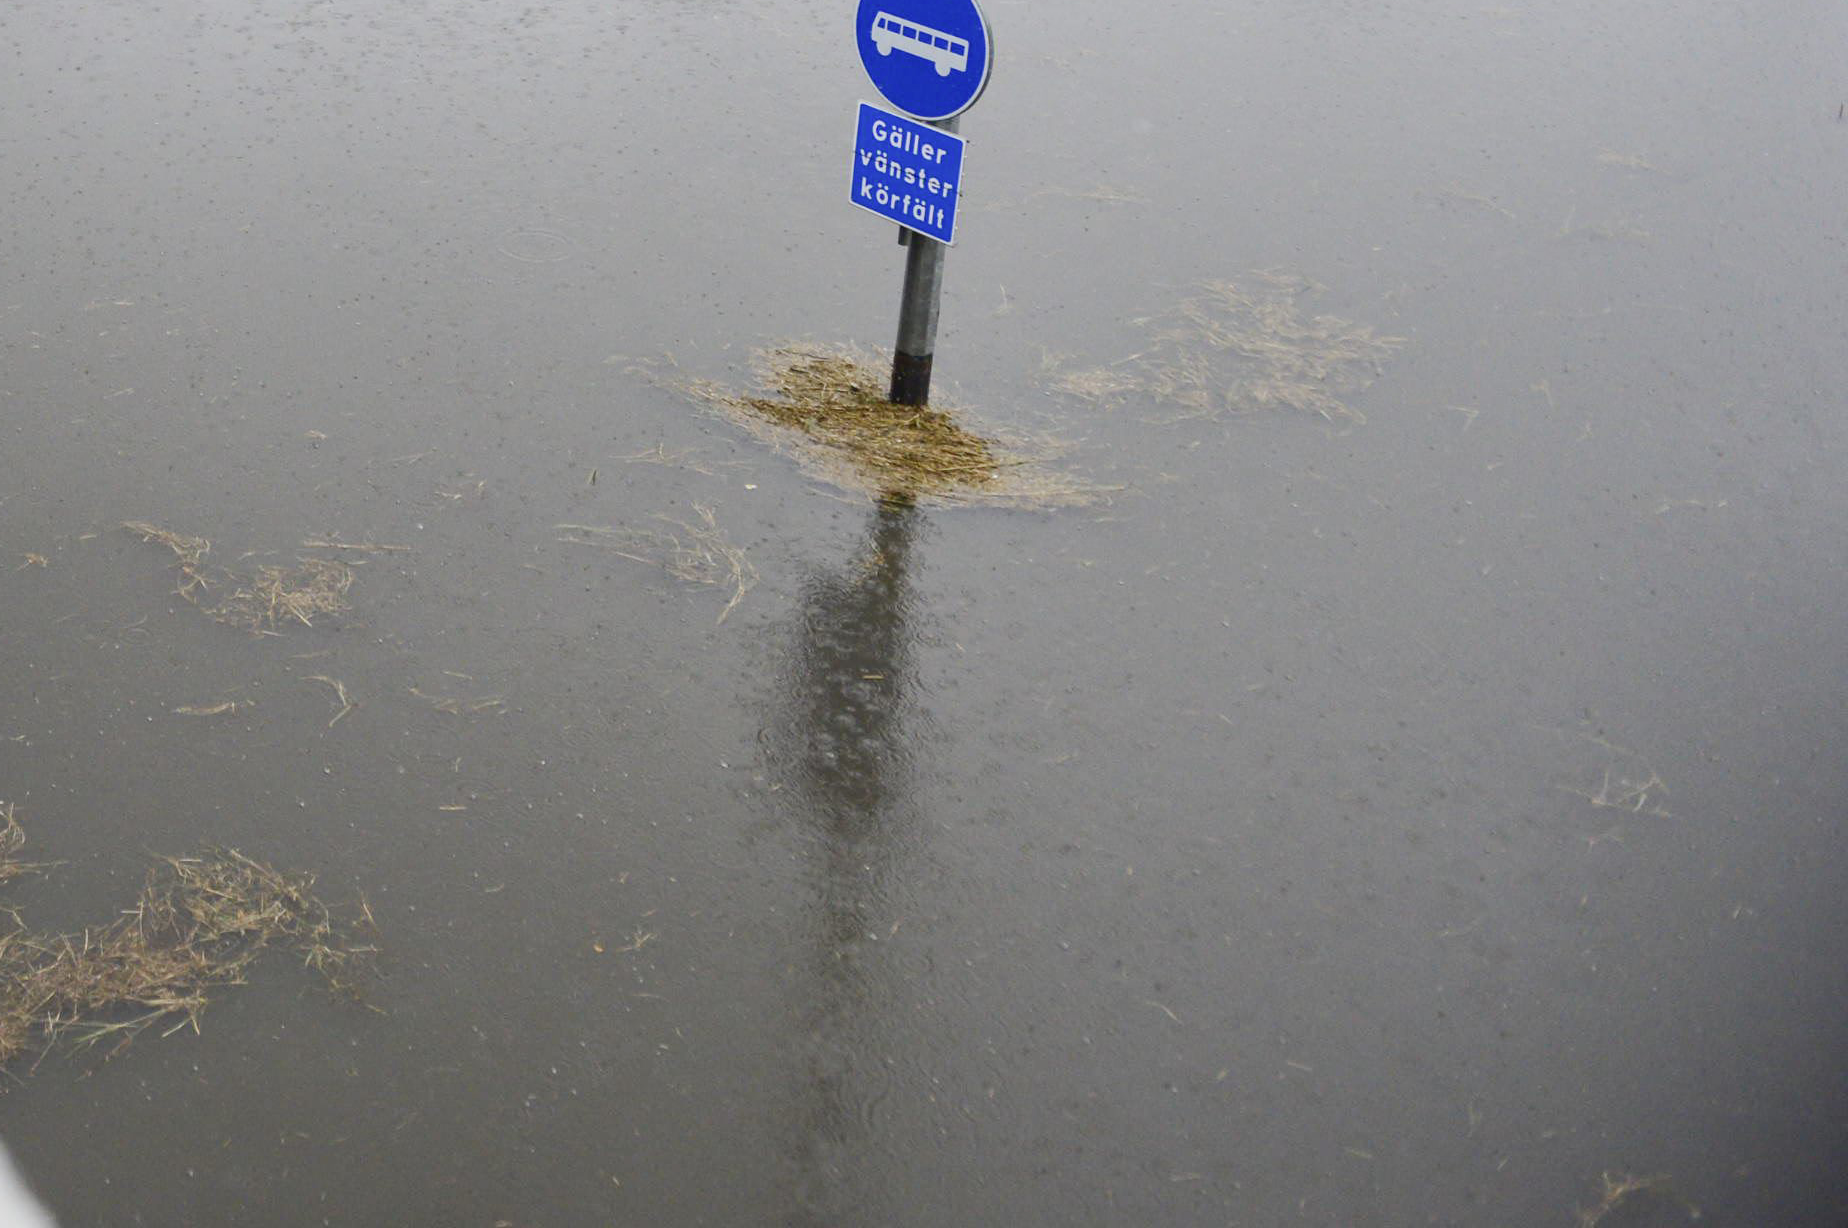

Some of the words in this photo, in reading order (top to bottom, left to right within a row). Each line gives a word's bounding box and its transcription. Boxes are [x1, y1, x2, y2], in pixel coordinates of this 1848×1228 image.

[872, 119, 947, 164] Gäller
[860, 148, 953, 198] vänster
[860, 176, 944, 229] körfält
